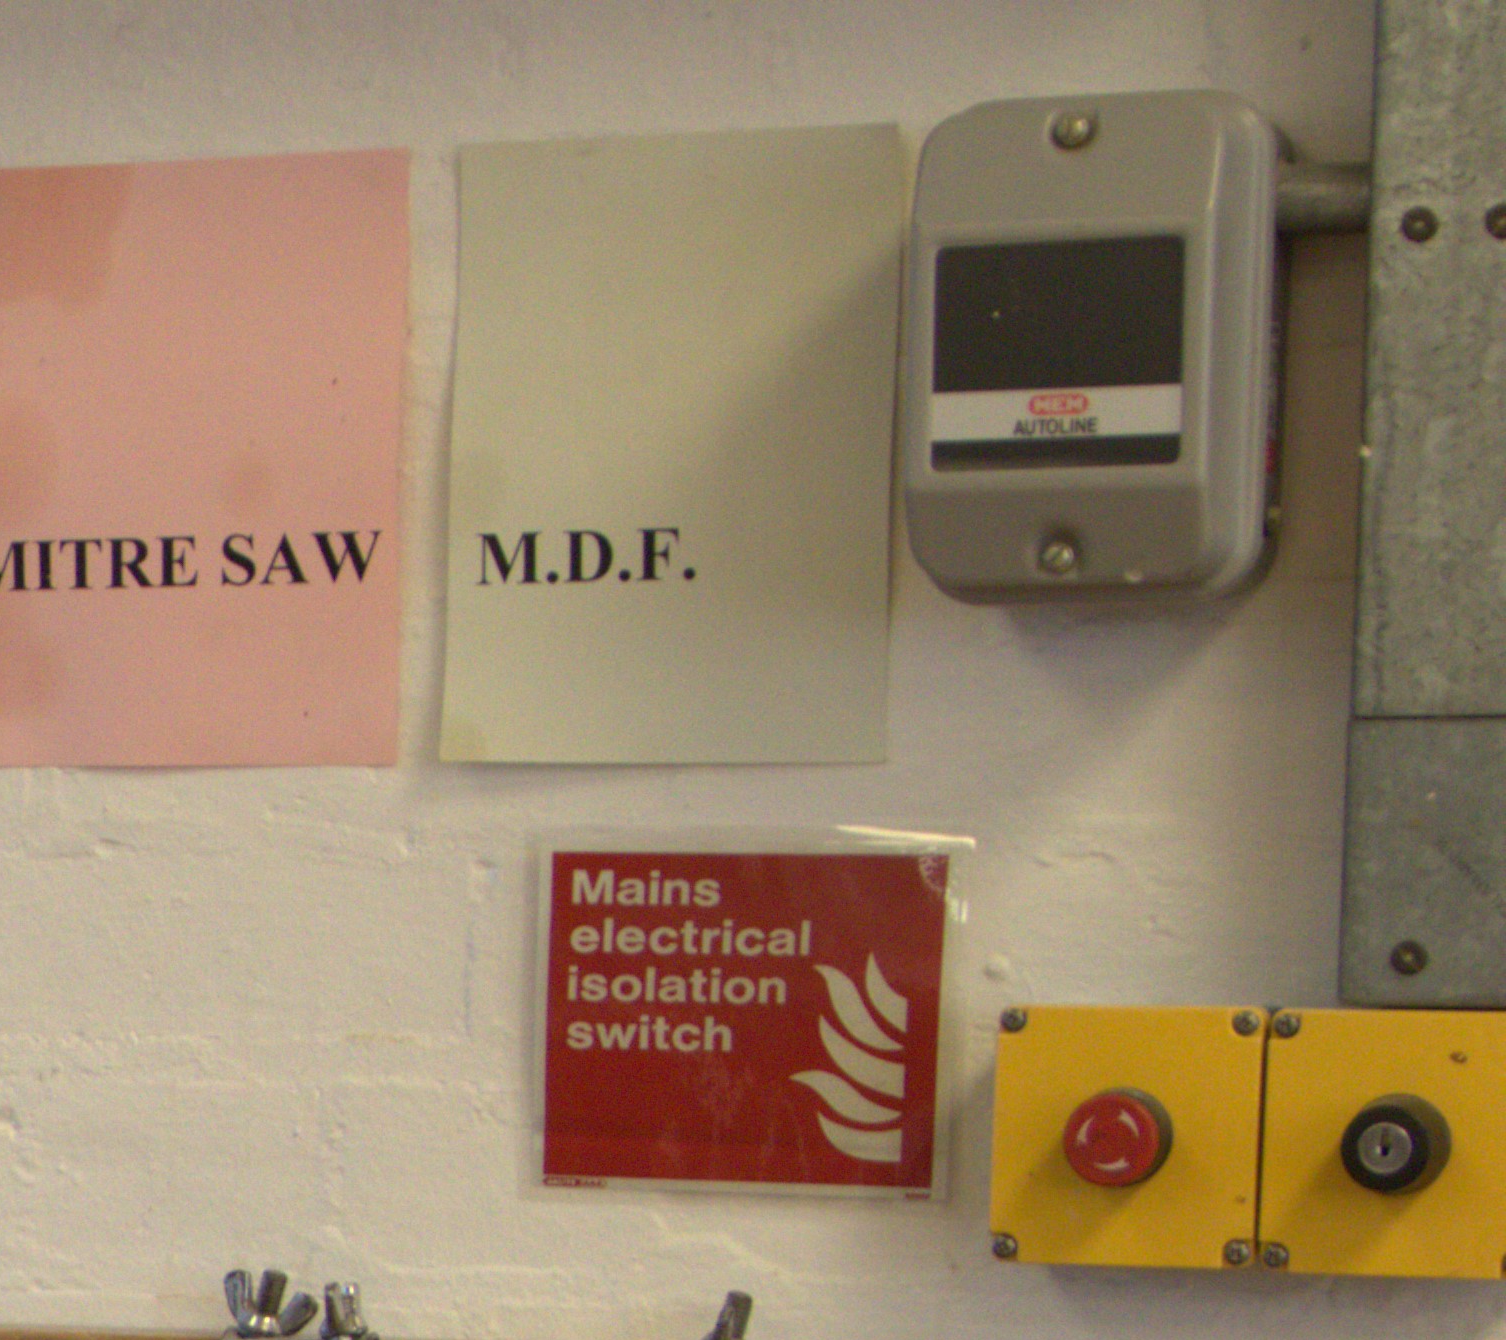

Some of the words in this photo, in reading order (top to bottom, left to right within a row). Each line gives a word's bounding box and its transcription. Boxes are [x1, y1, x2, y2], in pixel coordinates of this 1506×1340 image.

[1014, 417, 1098, 435] AUTOLINE
[220, 530, 382, 588] SAW
[476, 528, 695, 585] M.D.F.
[572, 869, 721, 906] Mains
[570, 917, 811, 956] electrical
[567, 965, 786, 1004] isolation
[566, 1014, 732, 1051] switch
